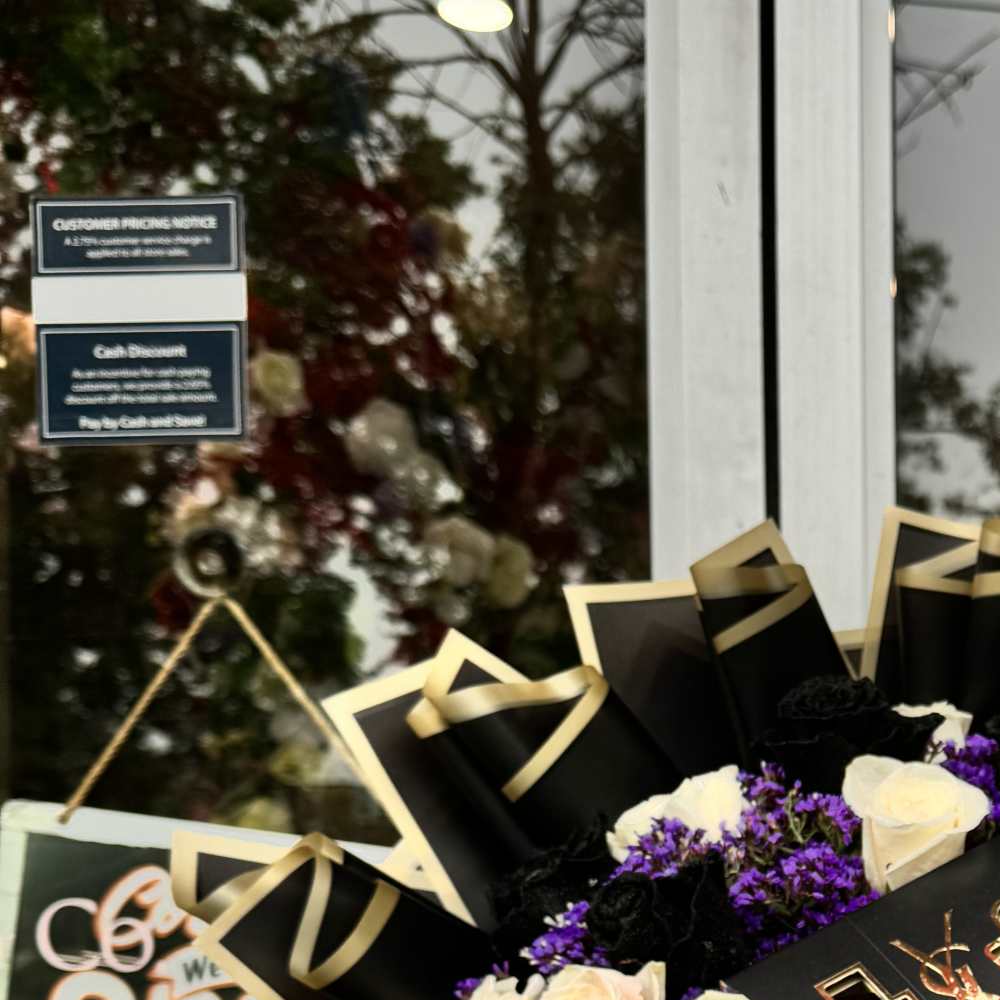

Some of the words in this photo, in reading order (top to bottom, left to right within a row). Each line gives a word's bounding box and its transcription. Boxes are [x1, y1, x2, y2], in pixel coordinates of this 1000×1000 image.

[52, 217, 120, 231] CUSTOMER
[121, 216, 172, 230] PRICING
[172, 215, 218, 230] NOTICE
[92, 343, 126, 359] Cash
[127, 342, 188, 359] Discount
[78, 415, 101, 431] Pay
[101, 415, 119, 431] by
[119, 414, 147, 429] Cash
[147, 414, 172, 429] and
